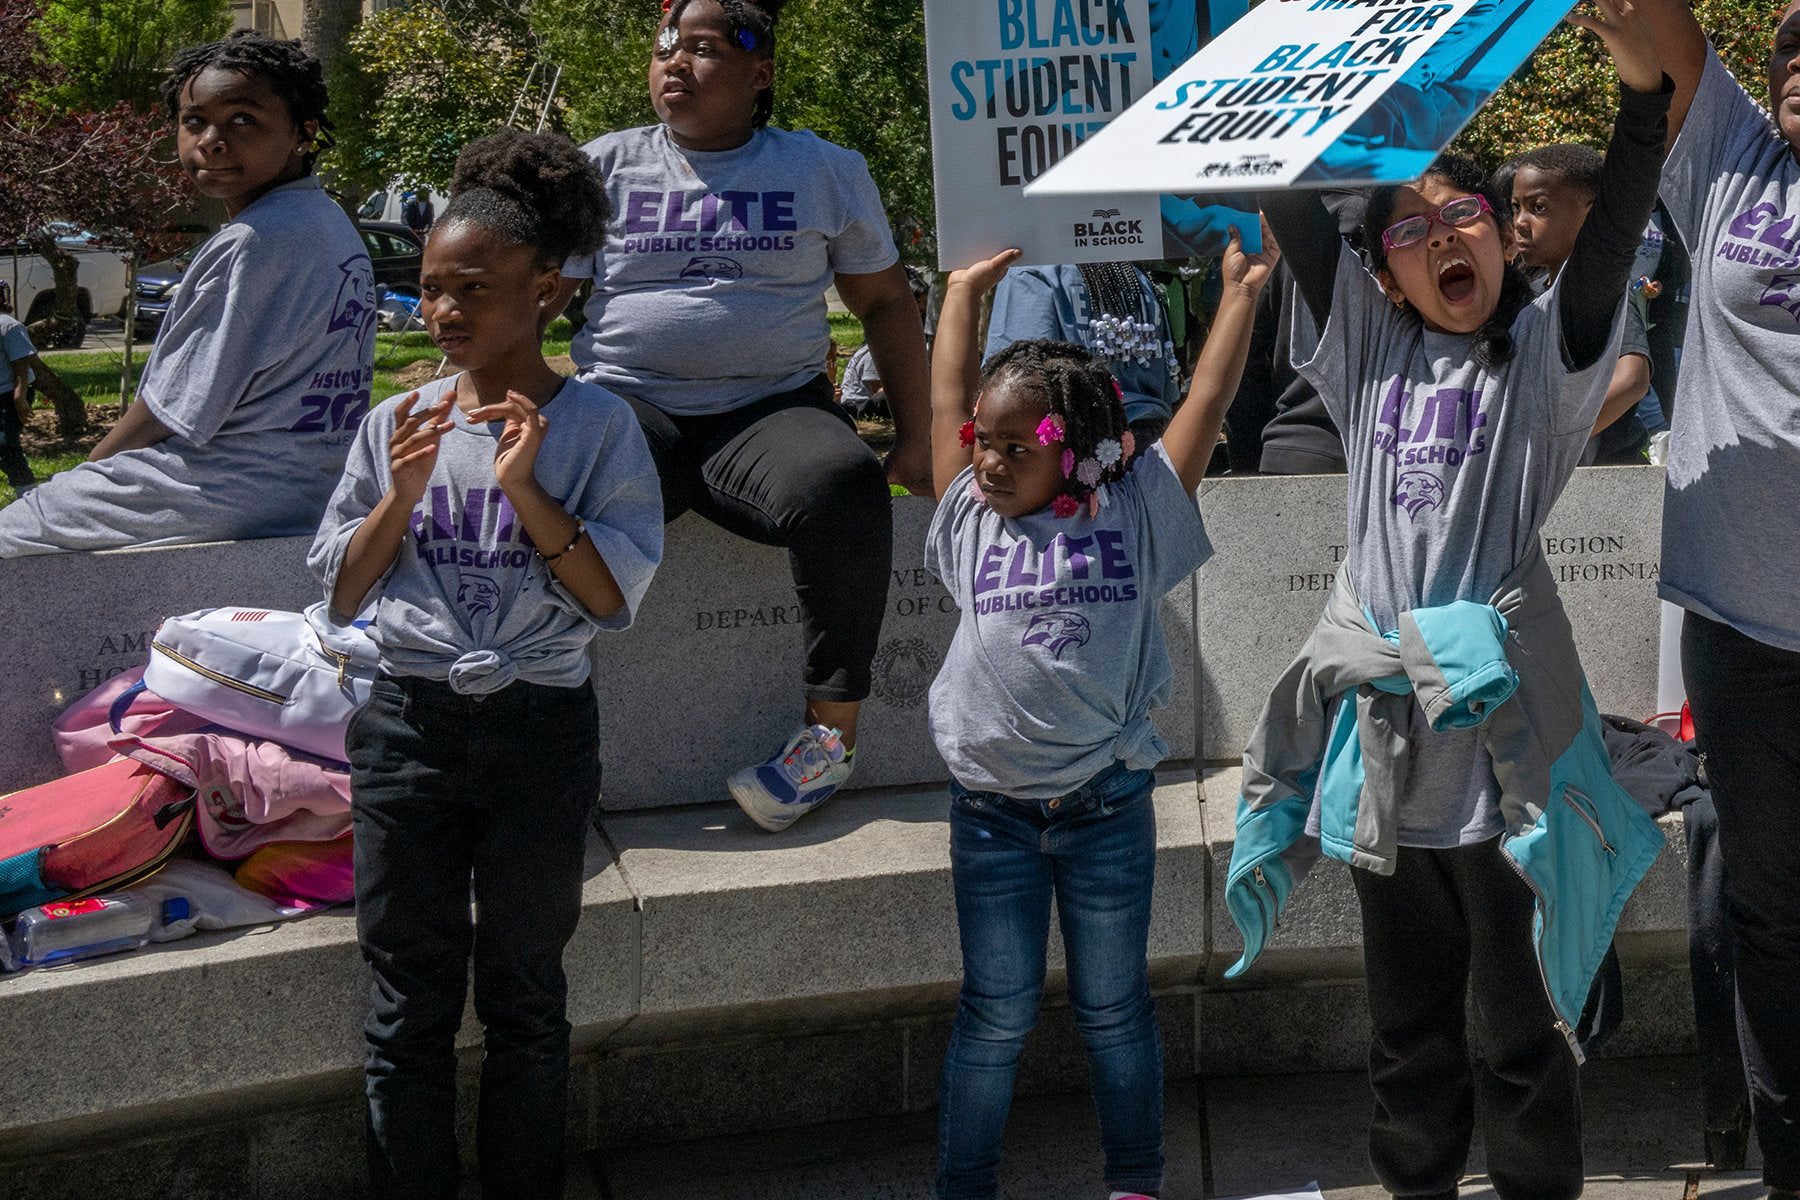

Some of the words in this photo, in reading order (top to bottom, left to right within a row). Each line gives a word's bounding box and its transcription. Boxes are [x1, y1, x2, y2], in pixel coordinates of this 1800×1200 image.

[1350, 3, 1454, 37] FOR
[1250, 35, 1424, 73] BLACK
[951, 52, 1137, 121] STUDENT
[1155, 69, 1391, 110] STUDENT
[1157, 104, 1352, 145] EQUITY
[626, 191, 797, 234] ELITE
[1074, 219, 1142, 237] BLACK
[624, 236, 695, 254] PUBLIC
[701, 235, 795, 251] SCHOOLS
[1074, 237, 1087, 247] IN
[1092, 235, 1144, 247] SCHOOL
[975, 530, 1134, 593] ELITE
[1545, 535, 1624, 555] EGION
[1553, 563, 1661, 582] IFORNIA
[897, 597, 930, 616] OF
[975, 588, 1035, 616] PUBLIC
[1040, 584, 1138, 607] SCHOOLS
